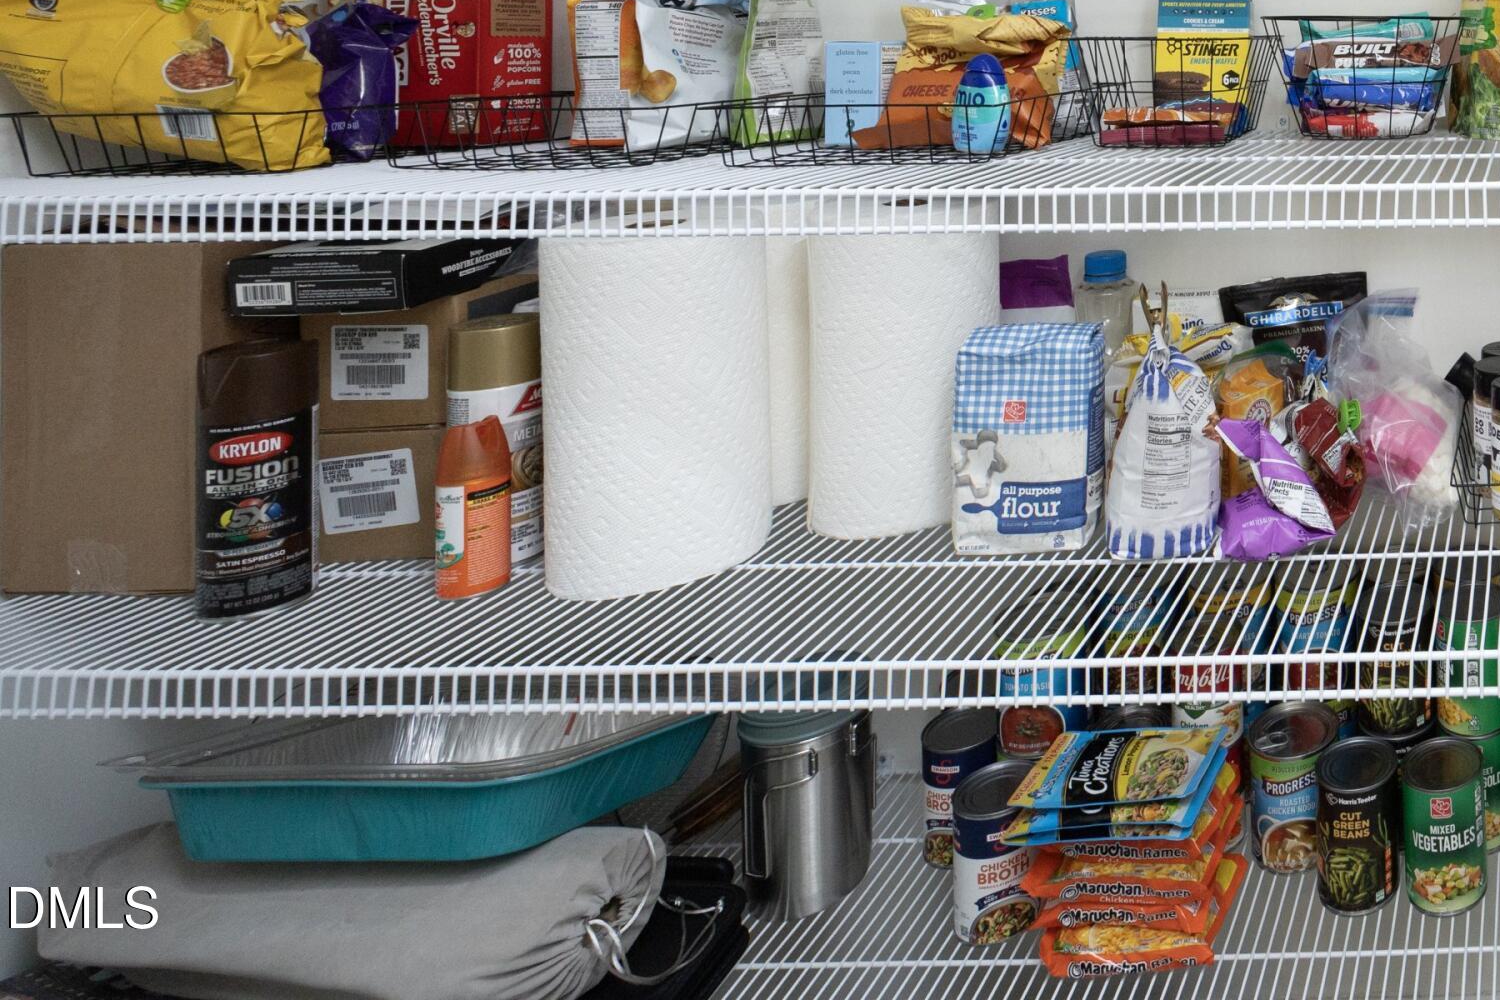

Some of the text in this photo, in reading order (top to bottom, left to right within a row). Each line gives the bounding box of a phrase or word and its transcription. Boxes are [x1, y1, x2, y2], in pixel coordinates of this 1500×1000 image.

[508, 48, 542, 59] 100%
[1183, 43, 1240, 57] STINGER
[1333, 44, 1396, 56] BUILT
[902, 84, 951, 98] CHEESE
[1249, 305, 1341, 327] GHIRARDELLI
[219, 437, 281, 459] KRYLON
[1003, 485, 1062, 497] all purpose
[1272, 479, 1303, 491] Nutrition
[1001, 498, 1061, 519] flour
[216, 549, 286, 569] SATIN ESPRESSO
[1083, 737, 1125, 795] Creations
[1069, 759, 1095, 790] Tuna
[1267, 804, 1297, 815] CHICKEN
[1340, 812, 1361, 822] CUT
[1333, 819, 1371, 831] GREEN
[1429, 823, 1456, 835] MIXED
[1333, 828, 1371, 840] BEANS
[1412, 828, 1476, 853] VEGETABLES
[1074, 842, 1189, 860] Maruchan Ramen
[980, 851, 1029, 873] CHICKEN
[977, 860, 1030, 886] BROTH
[1075, 883, 1191, 899] Maruchan Ramen
[1070, 908, 1134, 924] Maruchan
